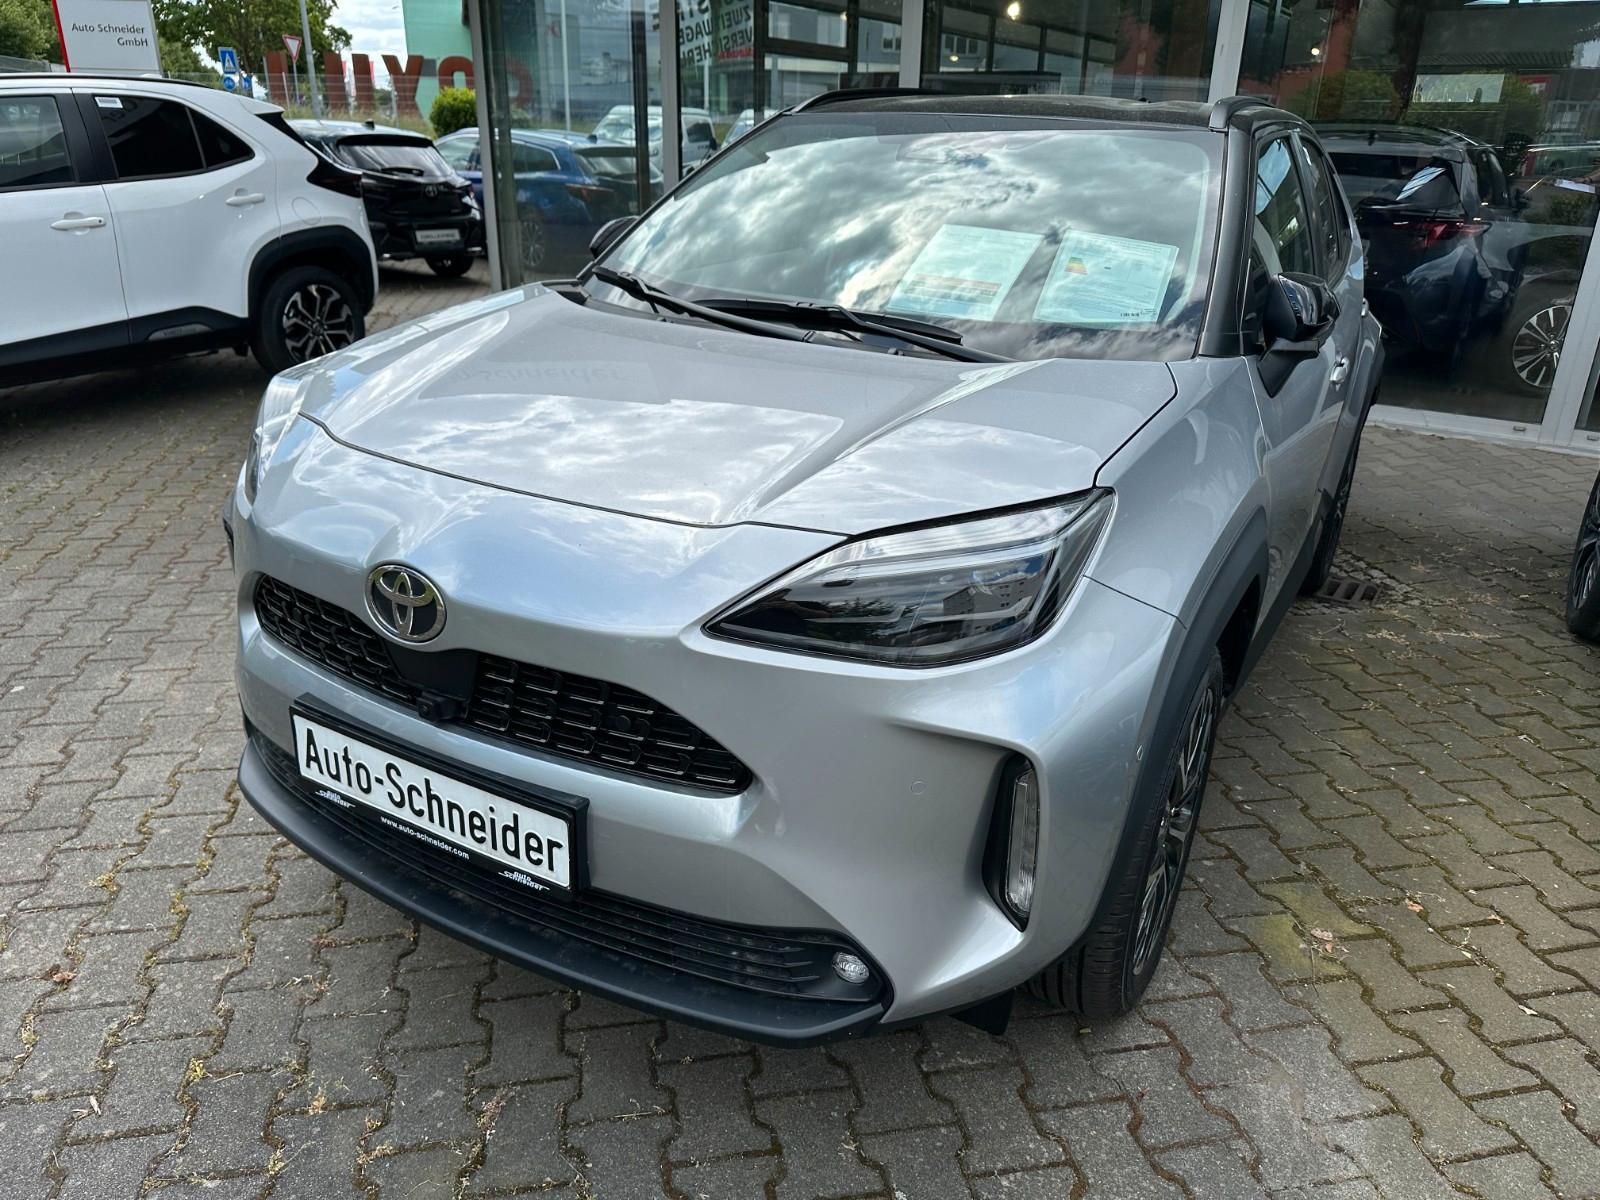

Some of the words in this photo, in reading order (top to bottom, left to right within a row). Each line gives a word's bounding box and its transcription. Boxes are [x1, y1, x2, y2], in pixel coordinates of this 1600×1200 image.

[71, 23, 95, 33] Auto
[97, 23, 145, 34] Schneider
[117, 37, 149, 47] GmbH
[304, 727, 564, 872] Auto-Schneider
[380, 815, 470, 861] www.auto-schneider.com
